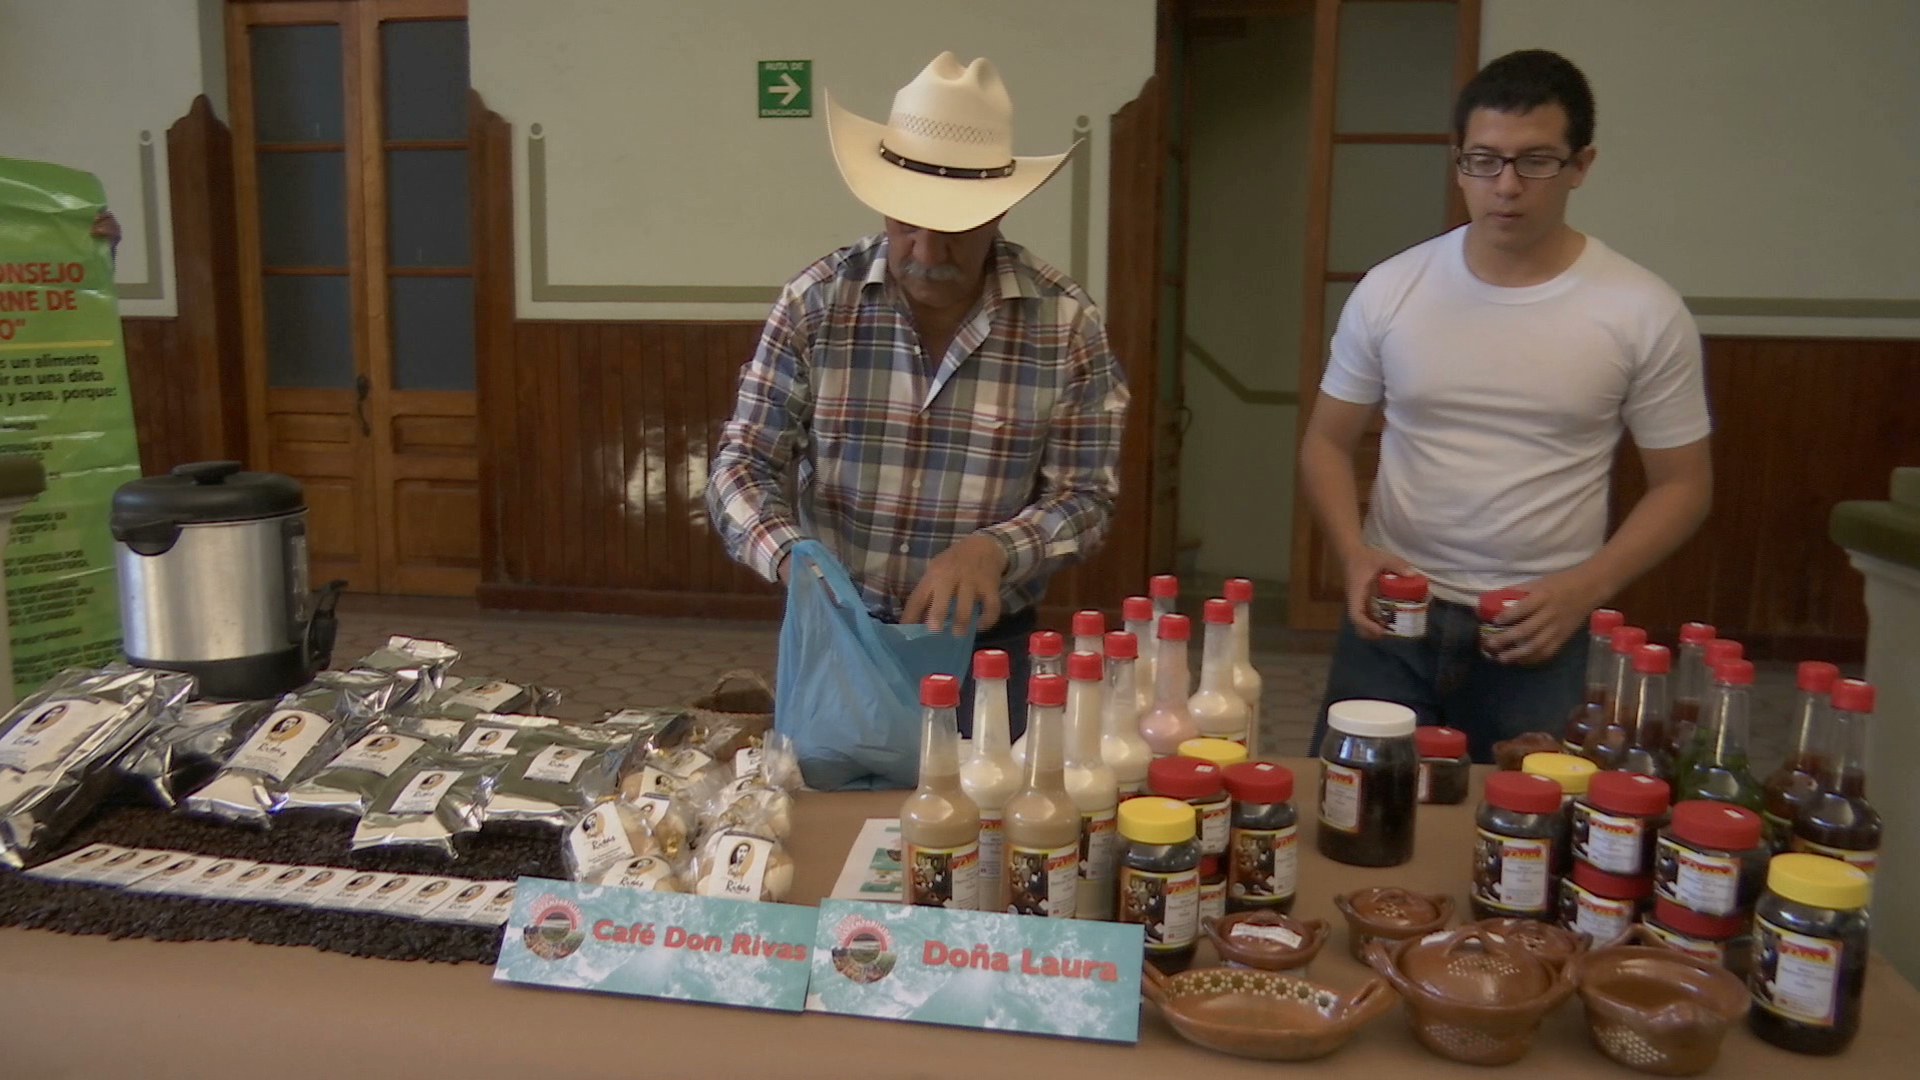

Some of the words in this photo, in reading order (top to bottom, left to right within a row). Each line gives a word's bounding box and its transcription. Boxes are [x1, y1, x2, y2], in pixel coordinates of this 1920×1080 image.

[46, 290, 78, 310] DE
[35, 354, 99, 368] alimento
[37, 373, 64, 384] una
[69, 369, 104, 382] dieta
[592, 835, 616, 850] Rivas
[726, 879, 751, 895] Rivas
[592, 919, 655, 946] Café
[664, 926, 722, 952] Don
[731, 933, 808, 961] Rivas
[922, 940, 1009, 972] Doña
[1020, 949, 1118, 982] Laura
